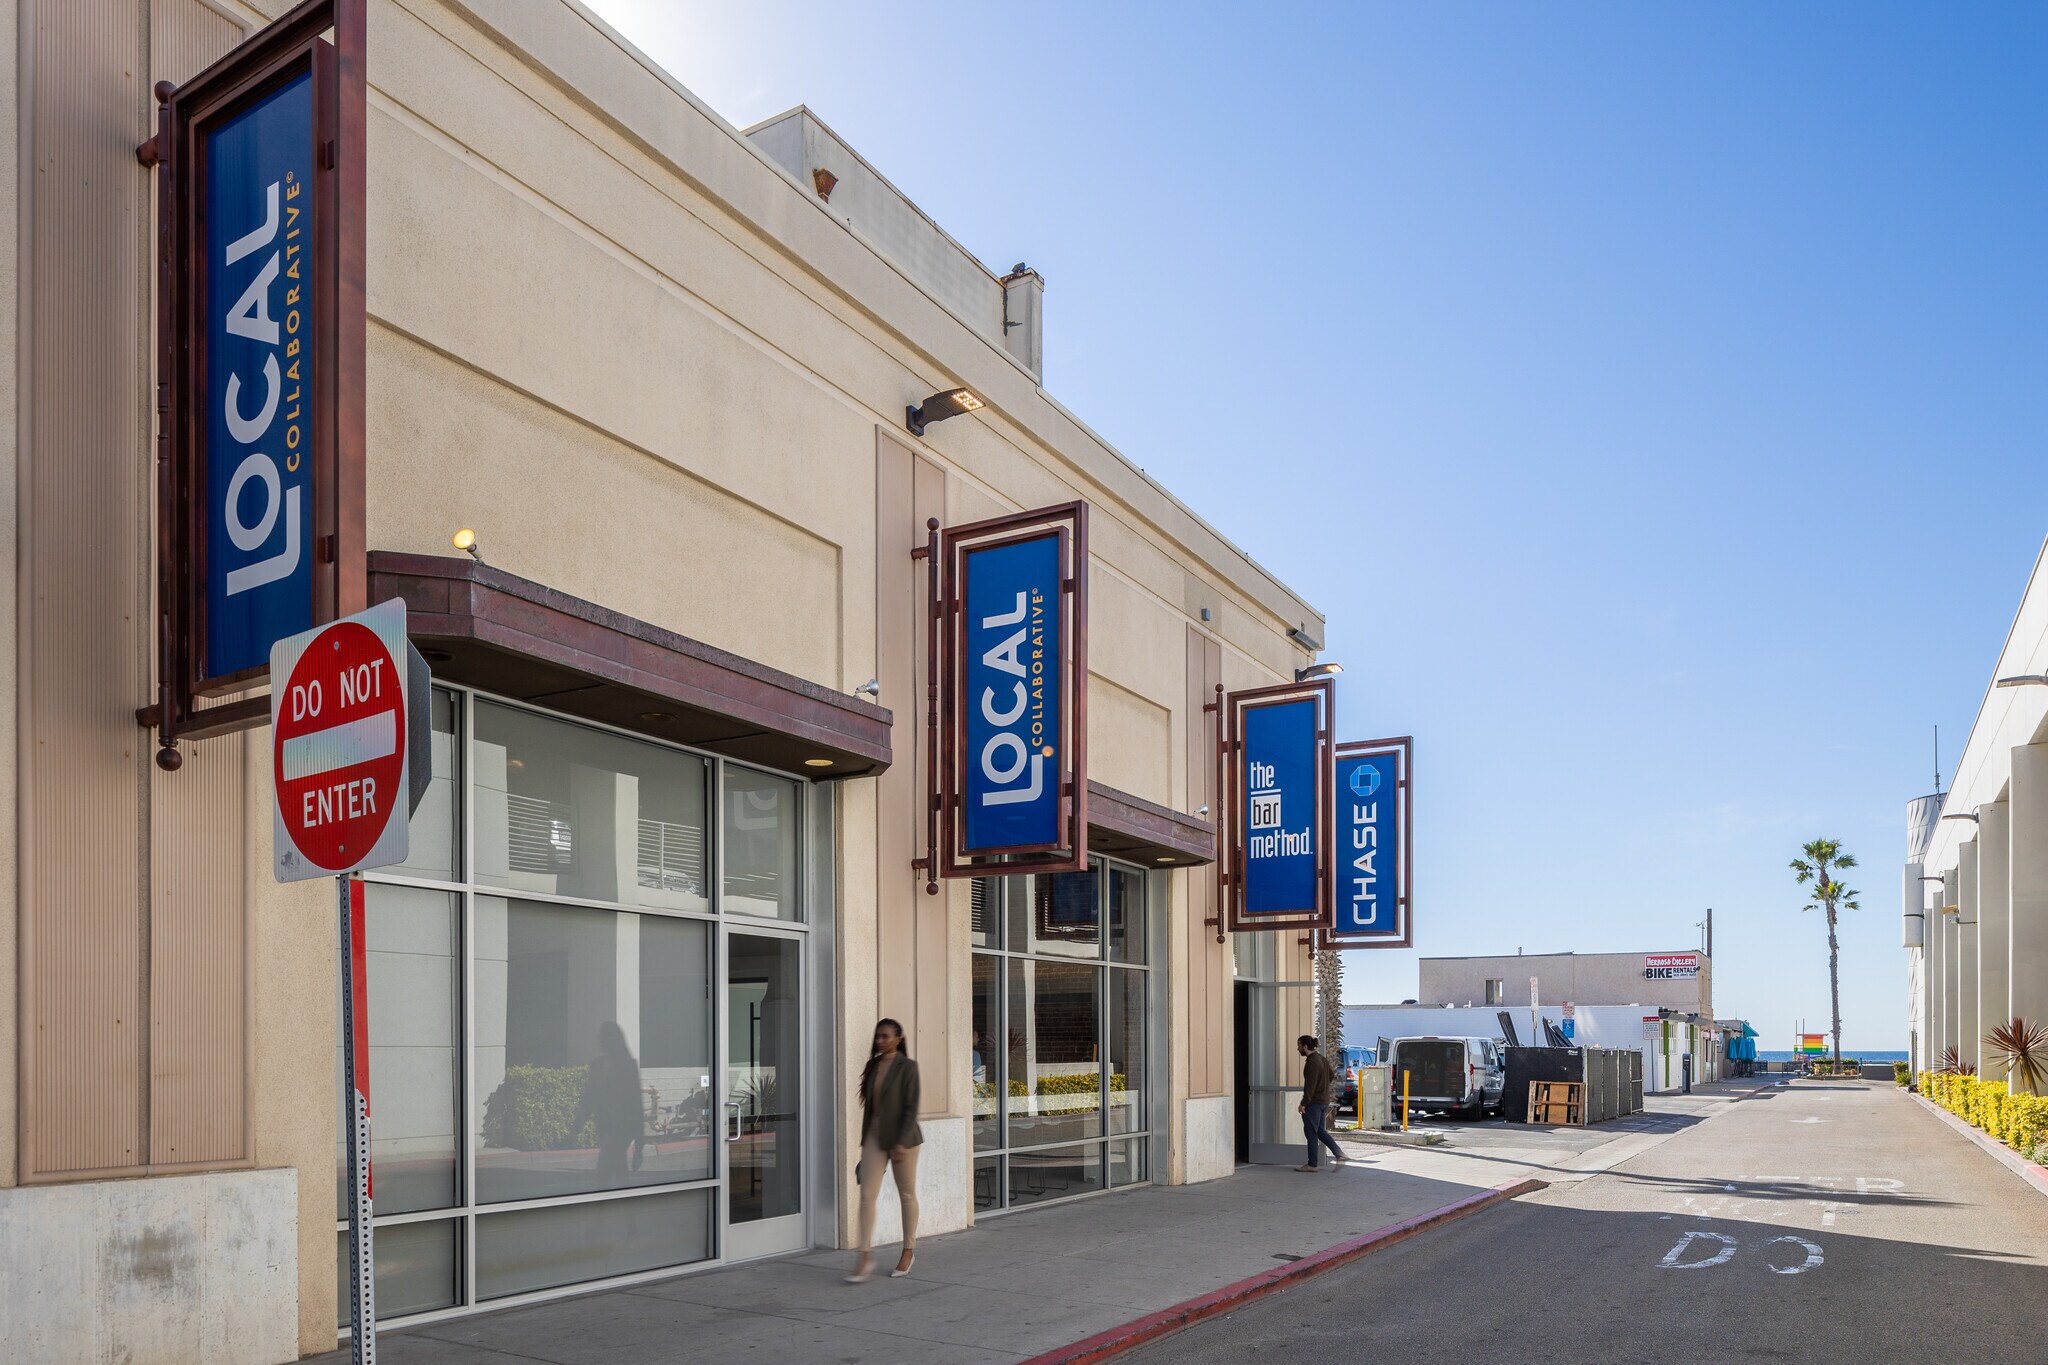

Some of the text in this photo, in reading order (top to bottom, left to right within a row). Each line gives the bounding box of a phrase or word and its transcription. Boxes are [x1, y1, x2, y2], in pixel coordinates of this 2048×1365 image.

[226, 181, 301, 597] LOCAL
[293, 658, 384, 722] DO NOT
[981, 591, 1043, 806] LOCAL
[303, 777, 377, 828] ENTER
[1251, 761, 1275, 789] the
[1253, 799, 1279, 826] bar
[1353, 802, 1377, 925] CHASE
[1646, 968, 1672, 978] BIKE
